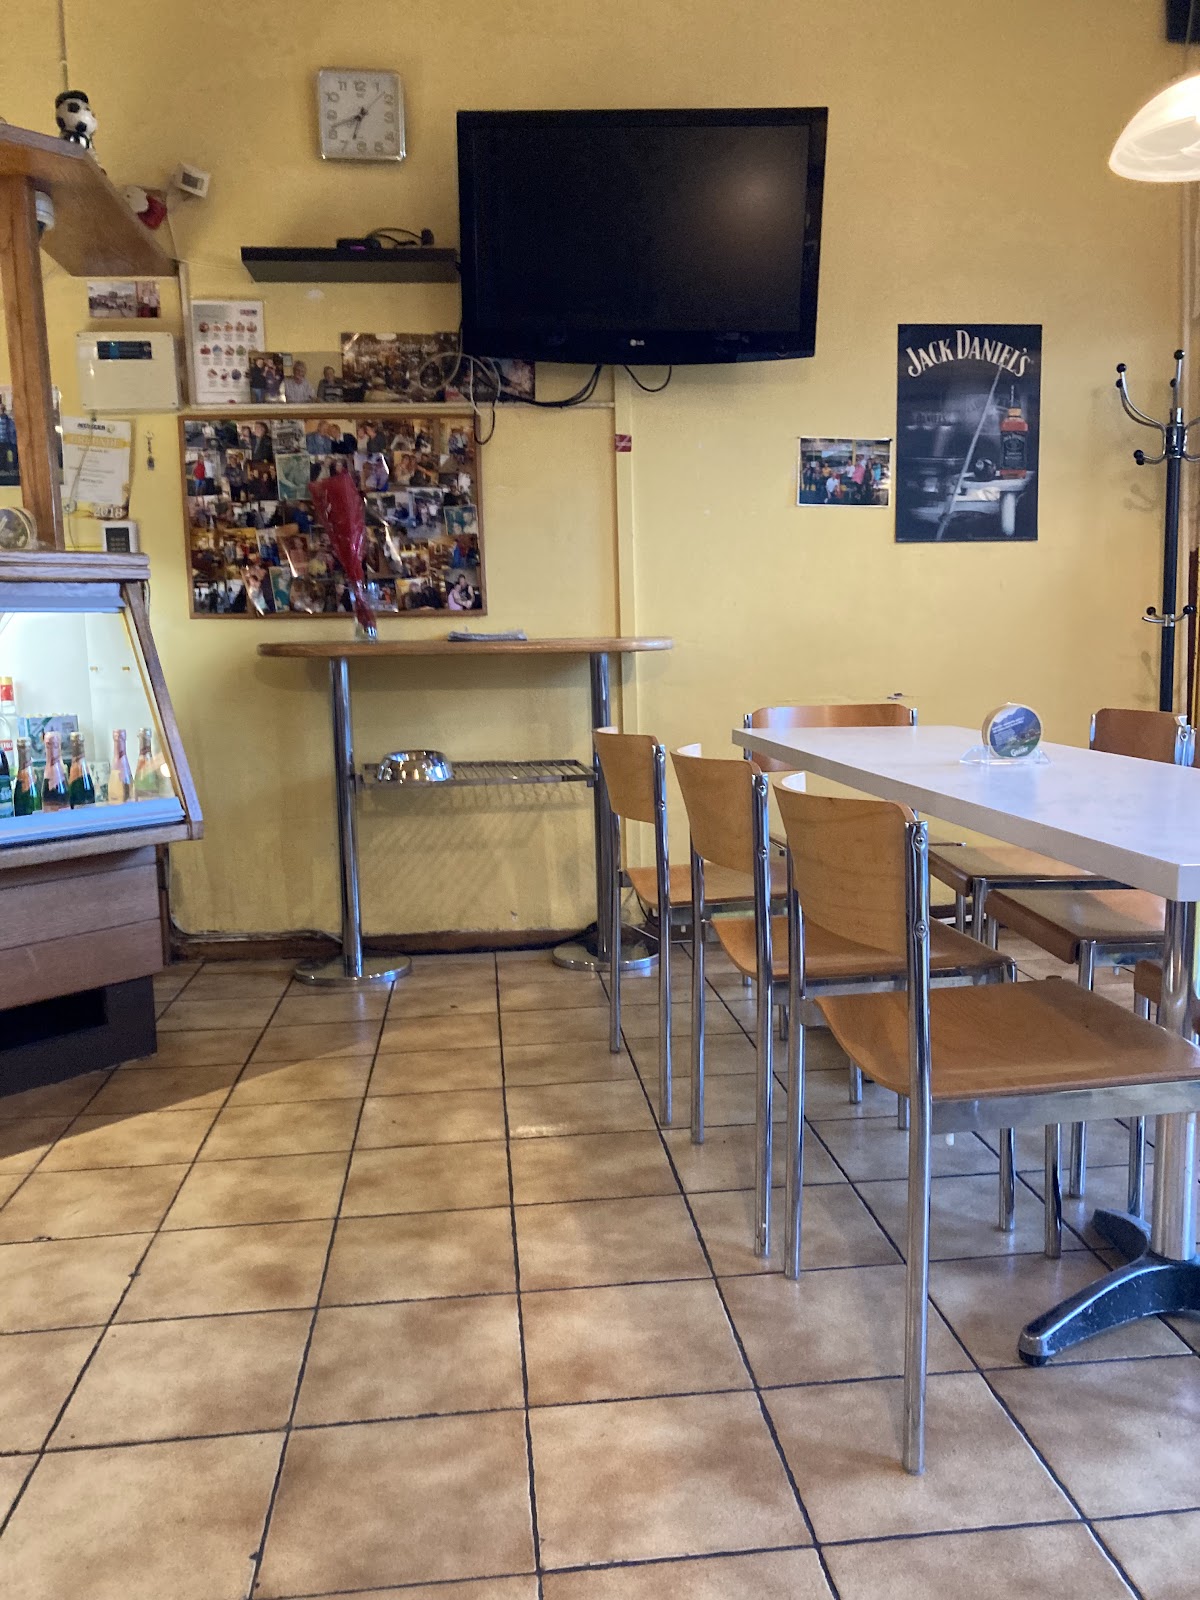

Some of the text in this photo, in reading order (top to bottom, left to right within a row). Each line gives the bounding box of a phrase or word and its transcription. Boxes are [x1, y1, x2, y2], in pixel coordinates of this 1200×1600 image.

[906, 330, 1031, 377] JACK DANIEL'S
[94, 506, 123, 518] 2018
